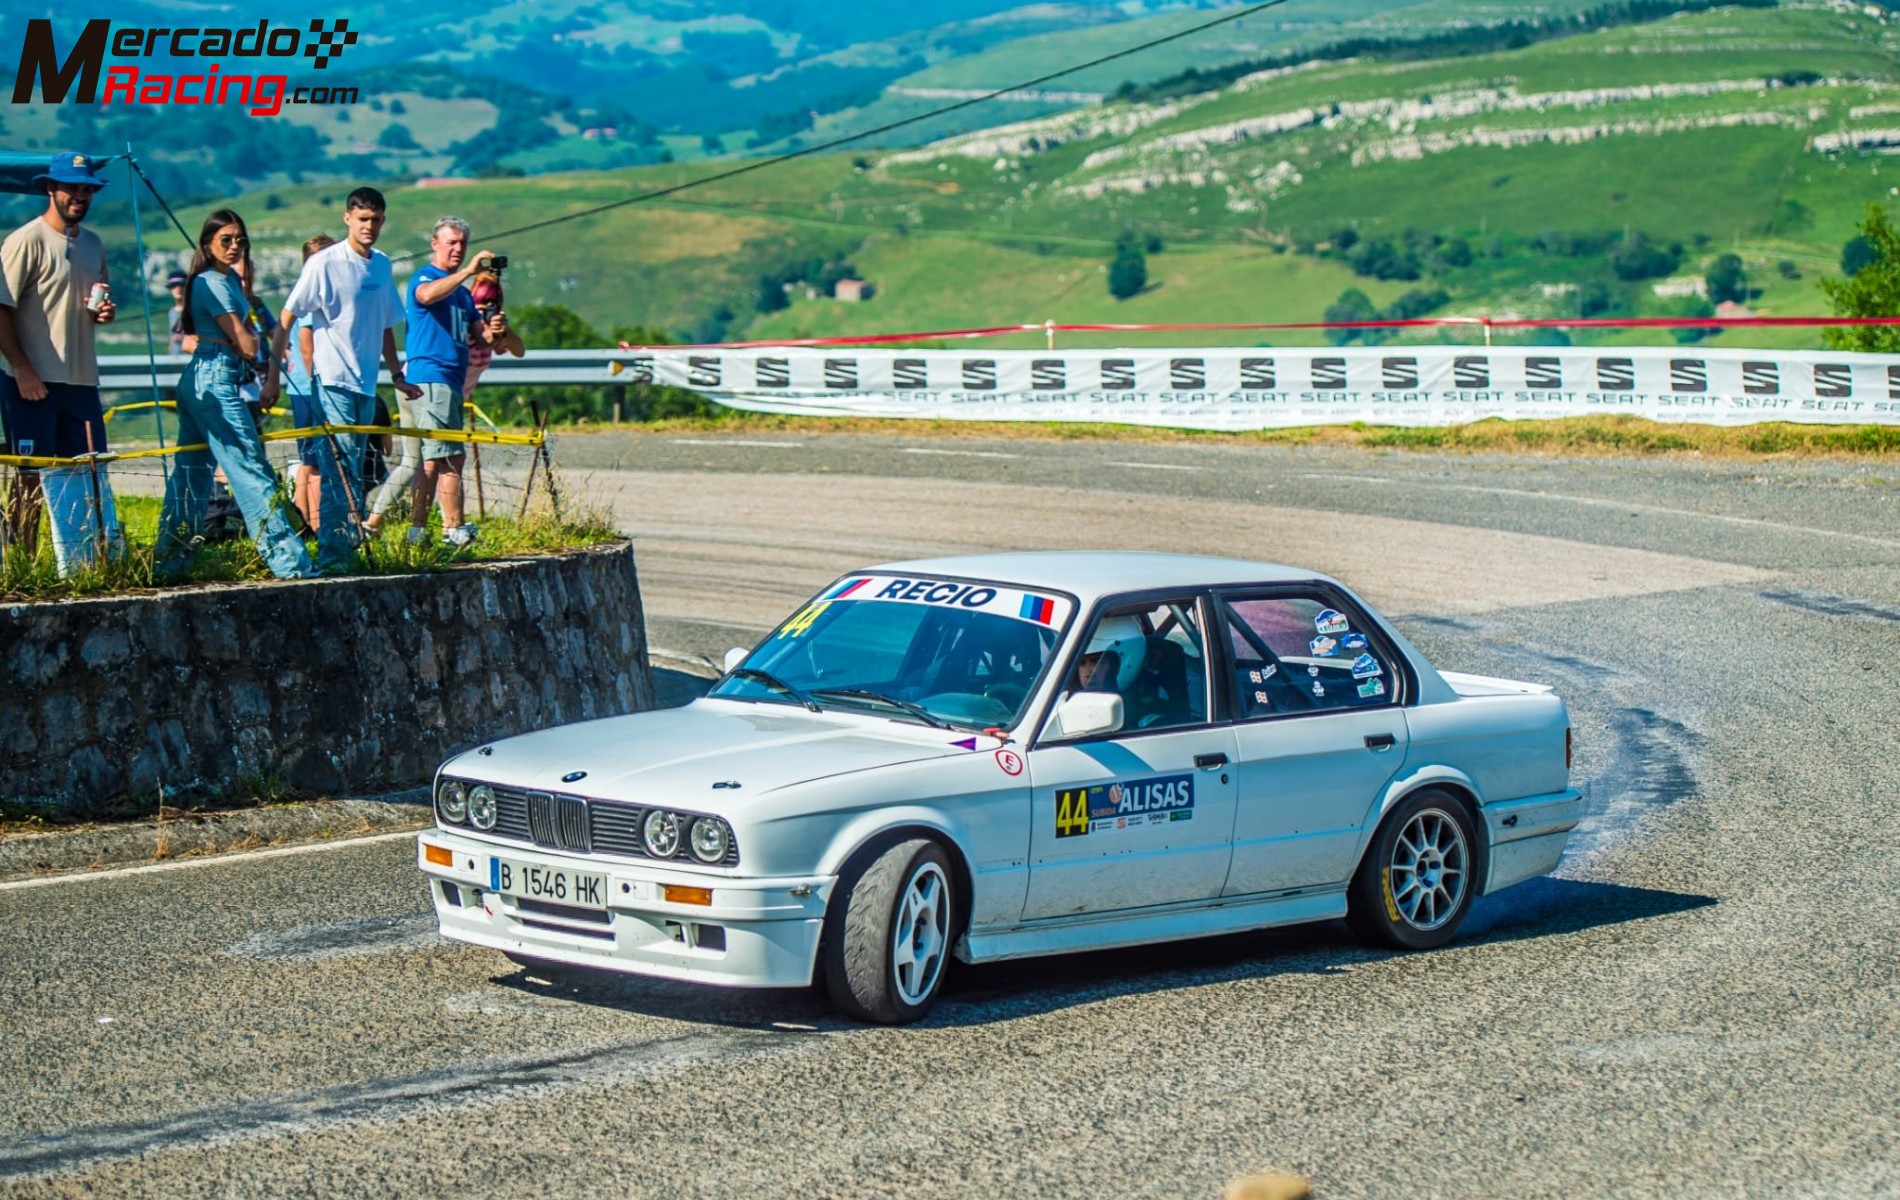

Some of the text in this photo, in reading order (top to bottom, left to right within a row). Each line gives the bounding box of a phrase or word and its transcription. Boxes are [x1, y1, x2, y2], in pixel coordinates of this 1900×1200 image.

[951, 392, 1010, 404] SEAT
[1017, 392, 1080, 403] SEAT
[1090, 392, 1149, 403] SEAT
[1159, 392, 1218, 403] SEAT
[1229, 391, 1290, 403] SEAT
[1300, 391, 1361, 403] SEAT
[1371, 391, 1432, 403] SEAT
[1442, 391, 1504, 402] SEAT
[1514, 391, 1576, 403] SEAT
[1586, 393, 1648, 404] SEAT
[1658, 395, 1720, 406] SEAT
[1730, 397, 1792, 409] SEAT
[1802, 399, 1864, 411] SEAT
[874, 579, 998, 607] RECIO
[777, 600, 834, 640] 44
[1056, 789, 1090, 836] 44
[1118, 780, 1189, 813] ALISAS
[501, 863, 601, 905] B 1546 HK
